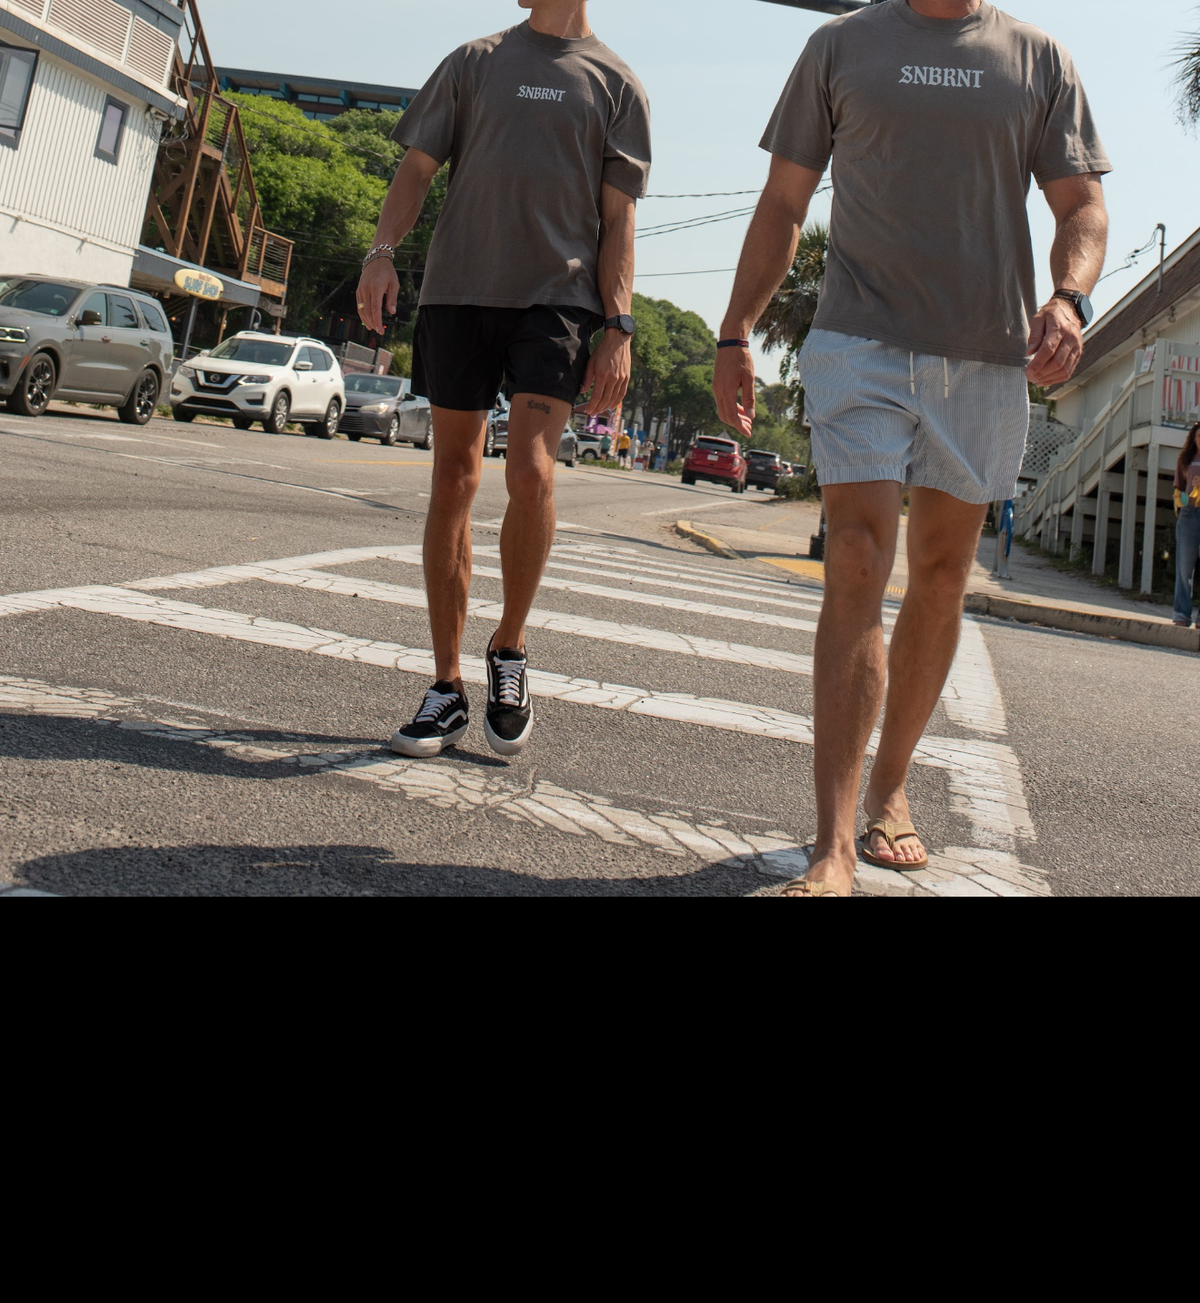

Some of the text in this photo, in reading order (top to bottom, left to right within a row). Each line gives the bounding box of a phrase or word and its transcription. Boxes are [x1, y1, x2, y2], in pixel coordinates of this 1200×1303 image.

[898, 65, 984, 88] SNBRNT
[516, 85, 566, 102] SNBRNT
[183, 276, 203, 293] SURF
[202, 281, 218, 298] SHOP
